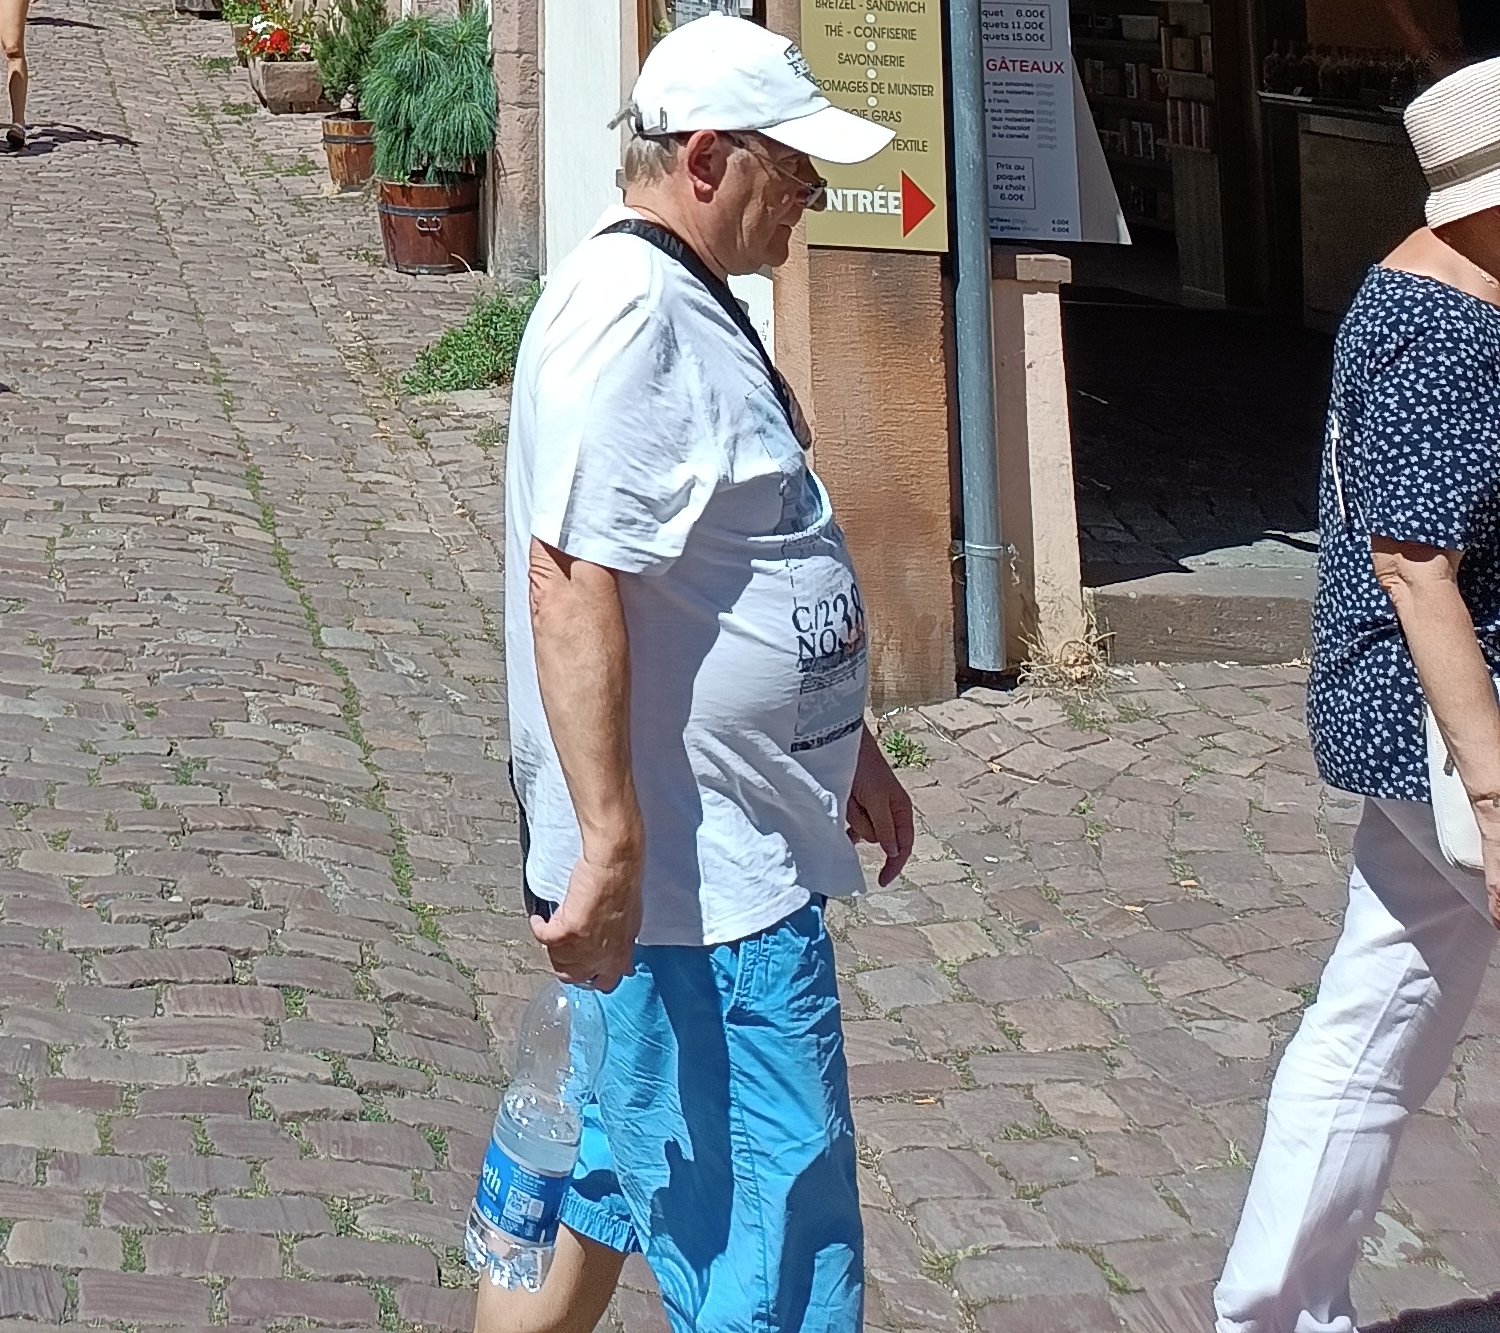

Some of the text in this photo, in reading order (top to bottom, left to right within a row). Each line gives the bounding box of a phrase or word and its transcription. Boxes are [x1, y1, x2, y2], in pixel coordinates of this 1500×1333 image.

[866, 0, 926, 14] SANDWICH
[981, 9, 1045, 19] quet 6.00€
[824, 21, 843, 37] THÉ
[853, 26, 917, 41] CONFISERIE
[981, 21, 1044, 30] quets 11.00€
[982, 33, 1045, 43] quets 15.00€
[838, 52, 905, 68] SAVONNERIE
[986, 56, 1065, 74] GÂTEAUX
[816, 79, 934, 97] ROMAGES DE MUNSTER
[872, 109, 902, 123] GRAS
[892, 138, 928, 153] TEXTILE
[996, 162, 1012, 170] Prix
[996, 174, 1026, 182] paquet
[1005, 183, 1025, 191] choix
[825, 184, 902, 215] NTRÉE
[1000, 193, 1024, 201] 6.00€
